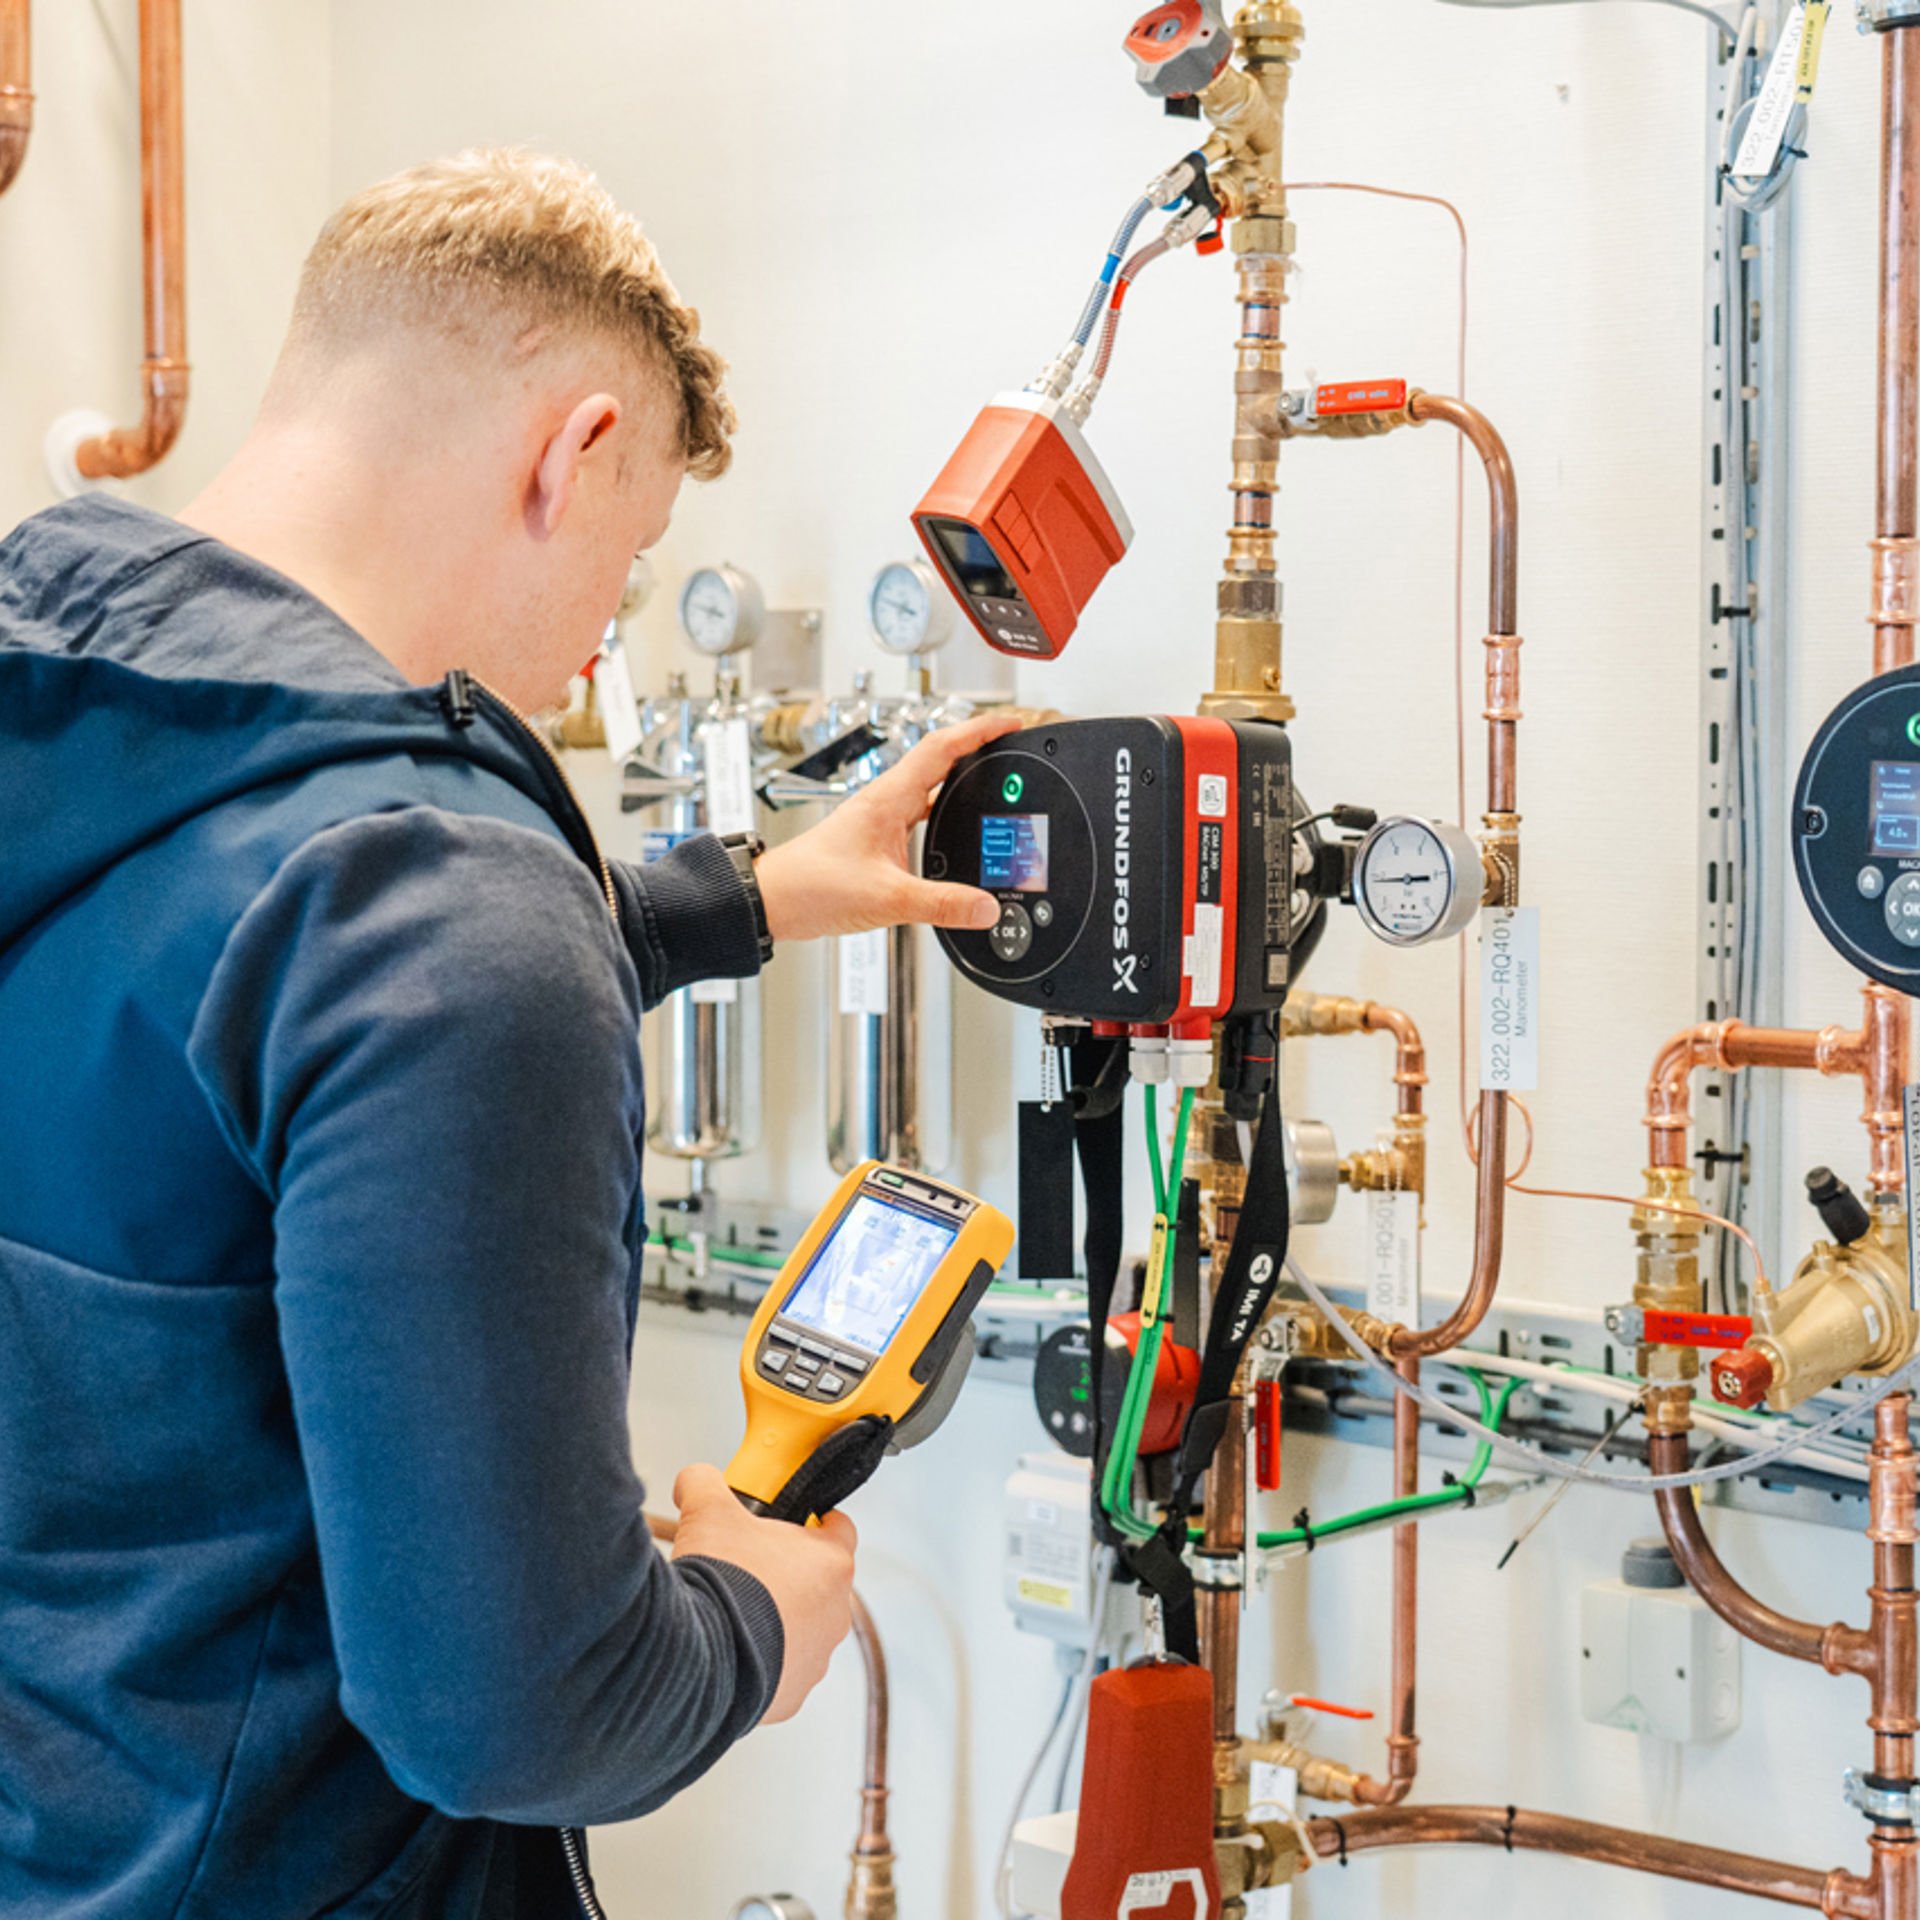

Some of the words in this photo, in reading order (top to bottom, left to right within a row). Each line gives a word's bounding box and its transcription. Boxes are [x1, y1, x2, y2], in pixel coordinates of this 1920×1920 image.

[1112, 747, 1132, 949] GRUNDFOS
[1001, 926, 1017, 938] OK
[1491, 918, 1512, 1082] 322.002-RQ401
[1515, 961, 1528, 1037] Manometer
[1376, 1197, 1395, 1322] 2.001-RQ501
[1230, 1319, 1248, 1342] TA
[1239, 1289, 1260, 1316] IMI
